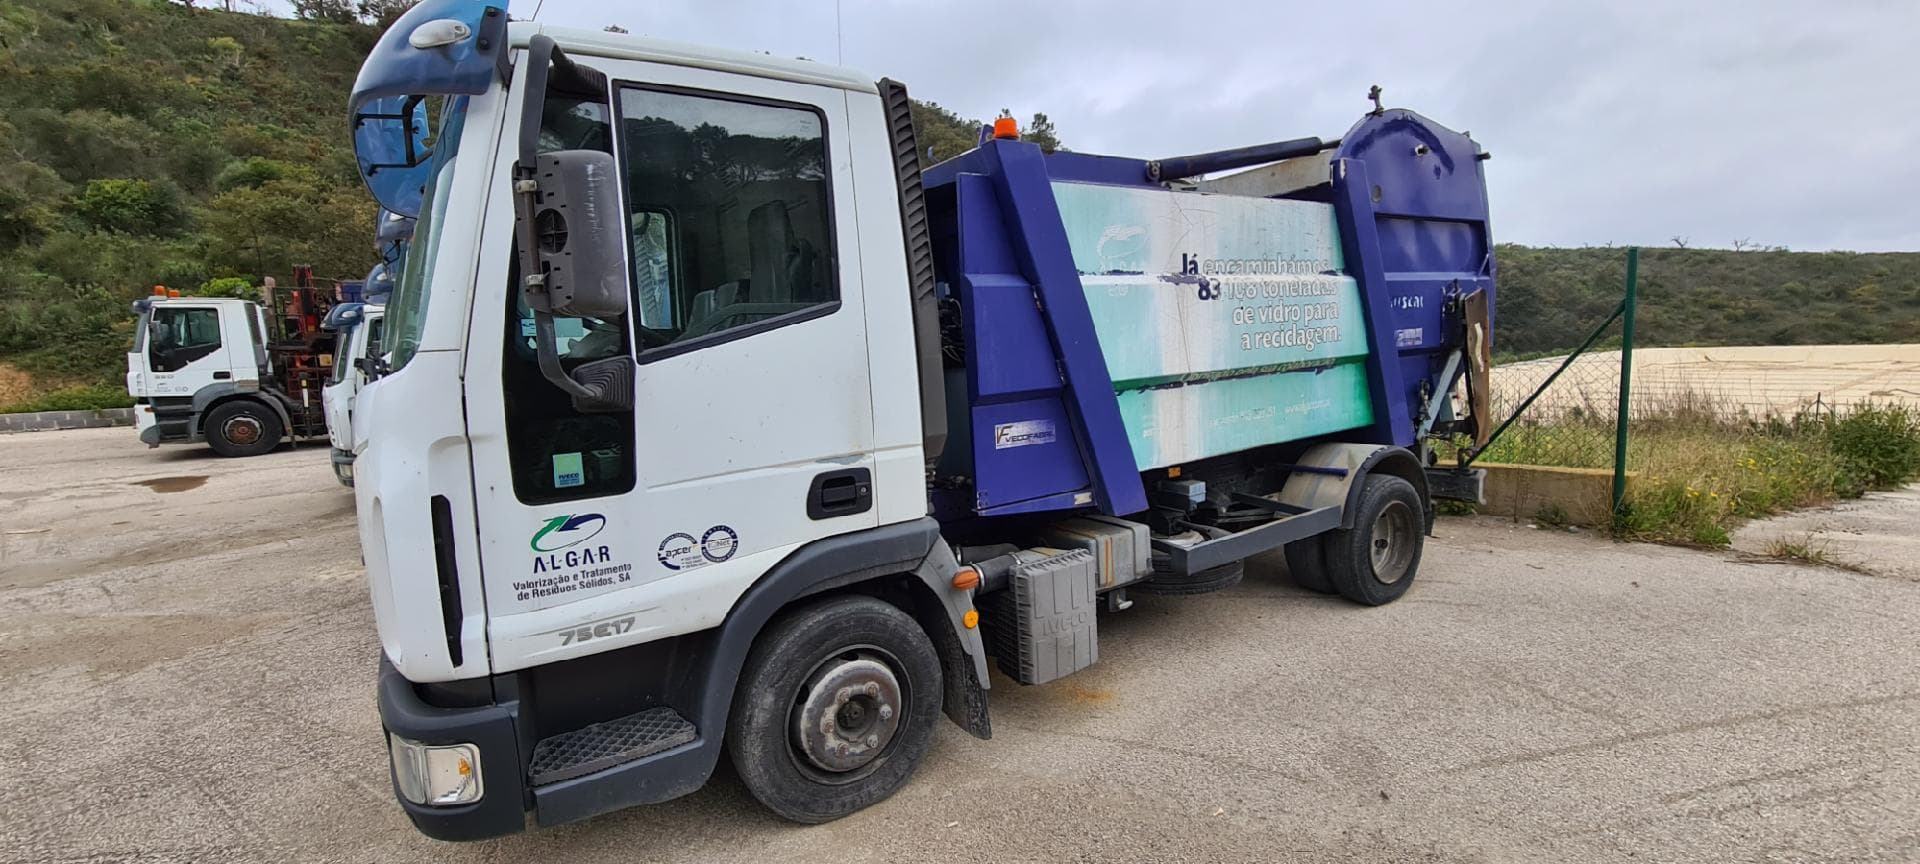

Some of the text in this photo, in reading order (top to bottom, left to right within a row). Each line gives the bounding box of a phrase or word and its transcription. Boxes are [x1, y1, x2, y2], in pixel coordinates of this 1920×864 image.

[1202, 252, 1328, 275] encaminhámos
[1198, 276, 1221, 300] 83
[1261, 278, 1338, 299] toneladas
[1232, 301, 1339, 327] de vidro para
[1241, 323, 1342, 351] a reciclagem.
[665, 545, 692, 559] apcer
[513, 562, 632, 592] Valorização e Tratamento
[517, 588, 530, 601] de
[532, 579, 577, 599] Resíduos
[618, 571, 631, 584] SA
[1042, 609, 1089, 637] IVECO
